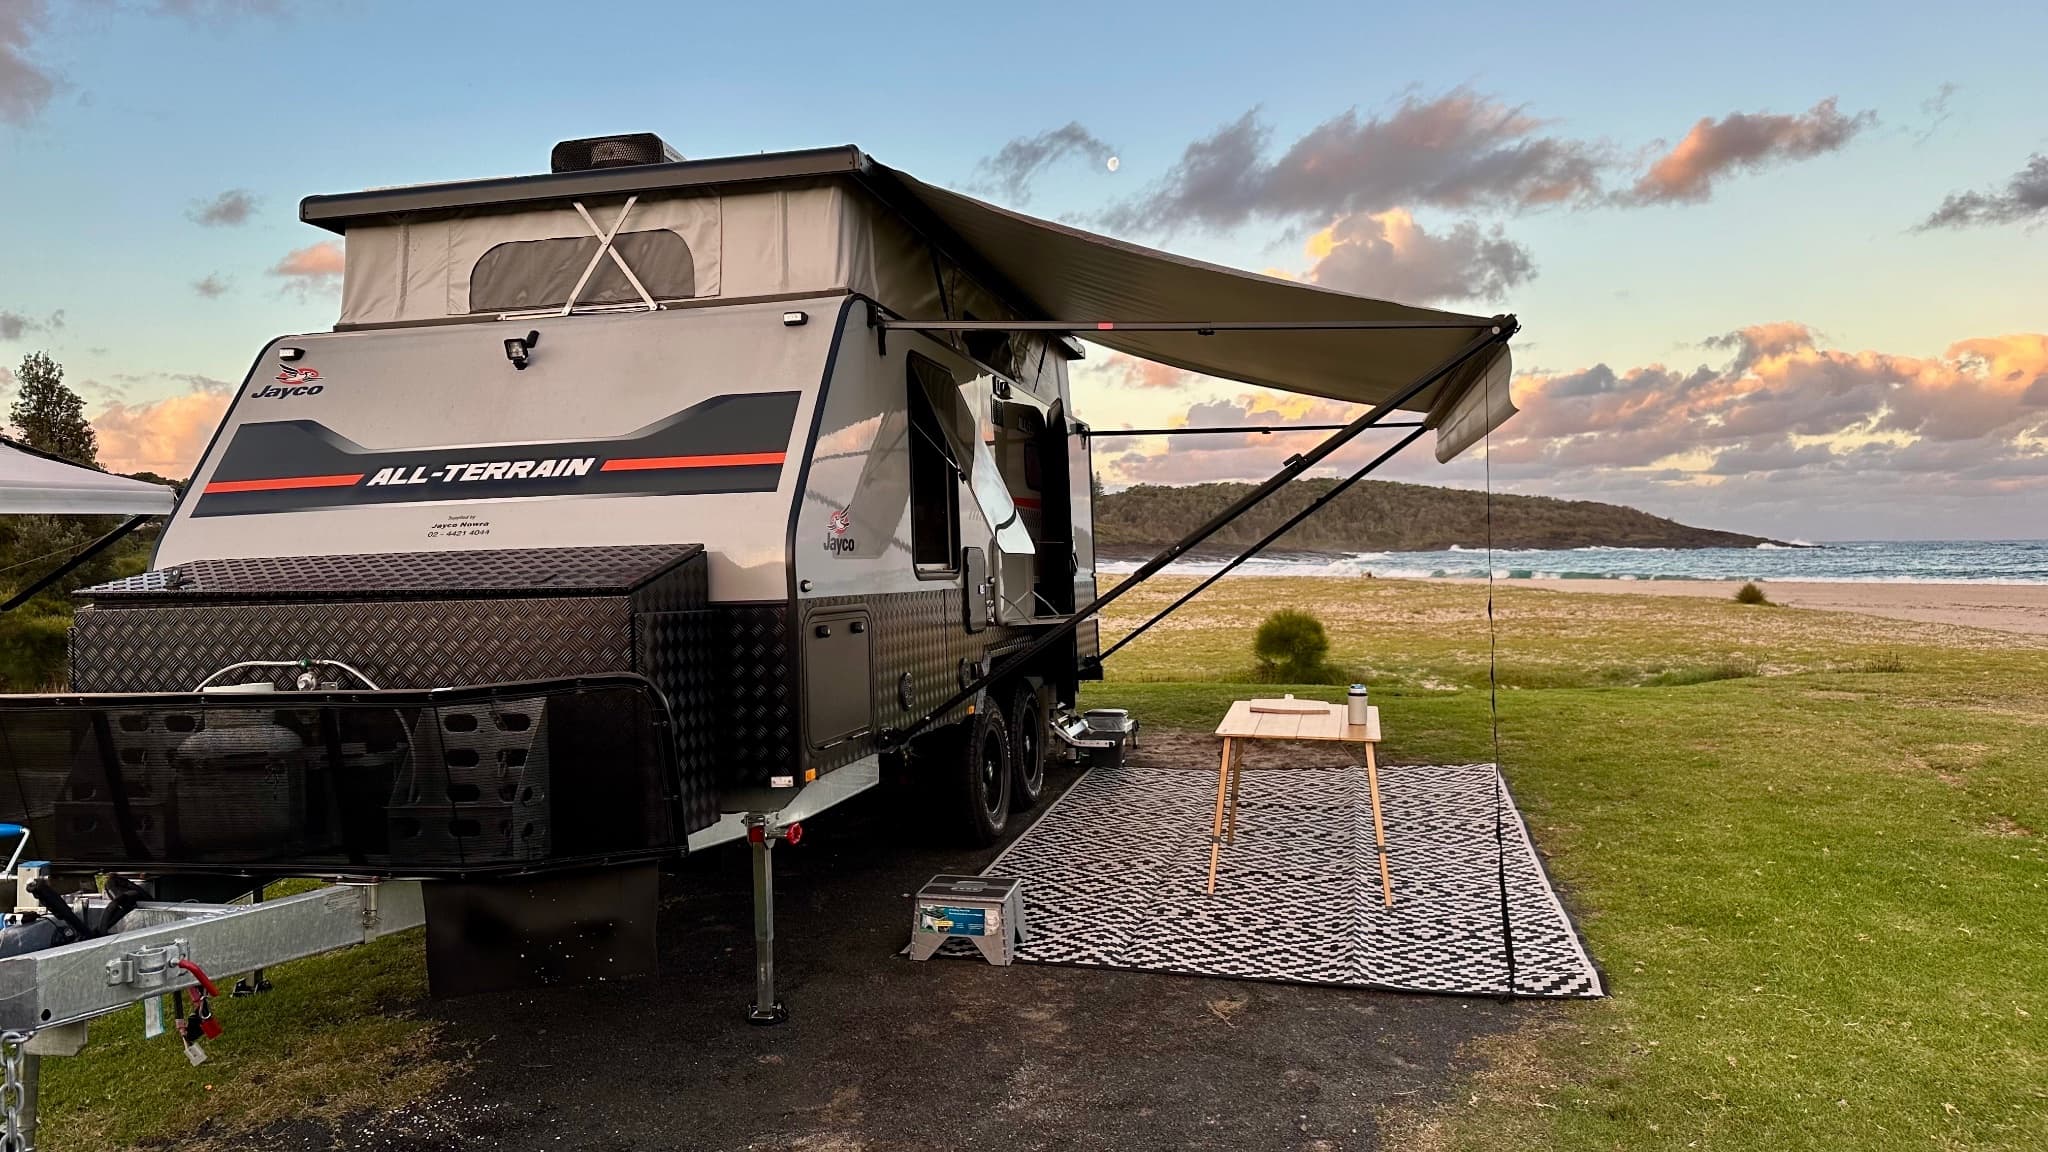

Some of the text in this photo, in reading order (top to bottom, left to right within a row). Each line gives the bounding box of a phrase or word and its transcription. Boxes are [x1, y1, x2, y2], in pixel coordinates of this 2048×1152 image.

[251, 385, 324, 399] Jayco
[366, 457, 596, 487] ALL-TERRAIN
[824, 533, 854, 555] Jayco
